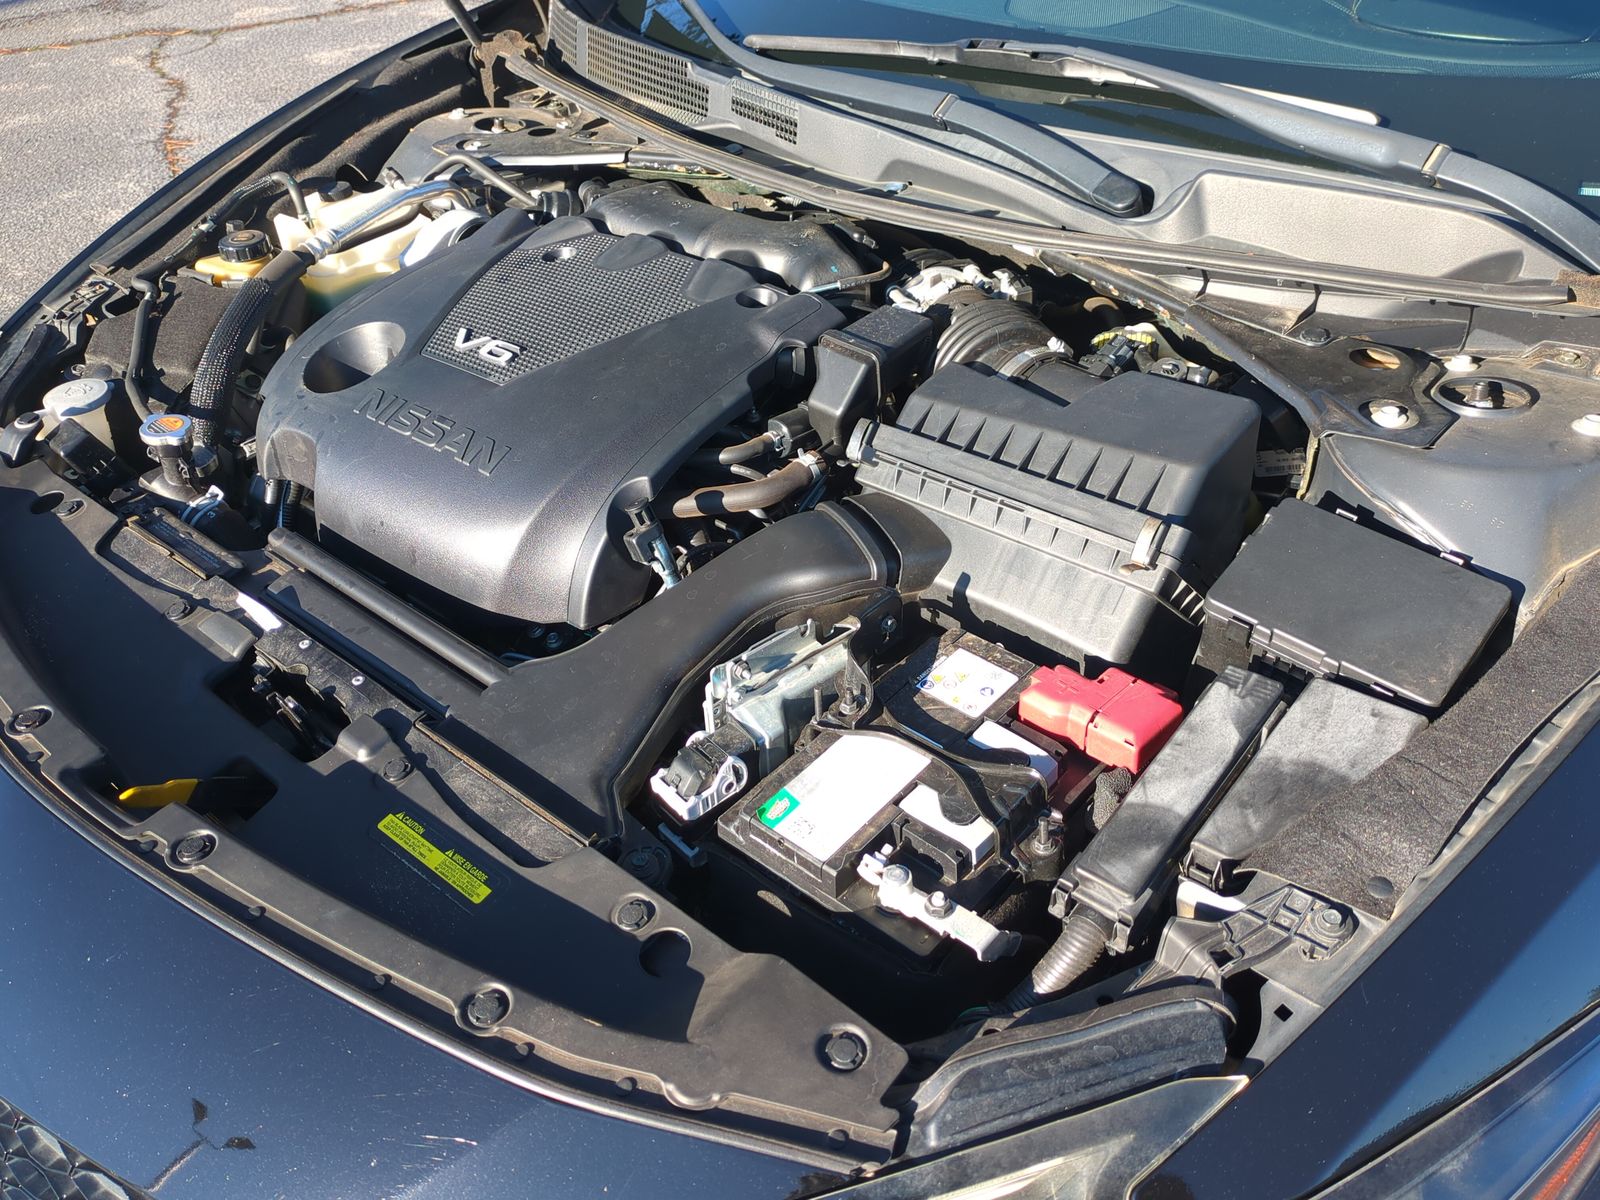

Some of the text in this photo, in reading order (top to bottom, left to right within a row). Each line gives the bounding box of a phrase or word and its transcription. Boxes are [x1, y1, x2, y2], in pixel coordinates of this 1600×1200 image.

[454, 327, 520, 366] V6
[353, 388, 512, 476] NISSAN
[402, 816, 426, 834] CAUTION
[462, 861, 473, 870] EN
[470, 866, 488, 882] GARDE
